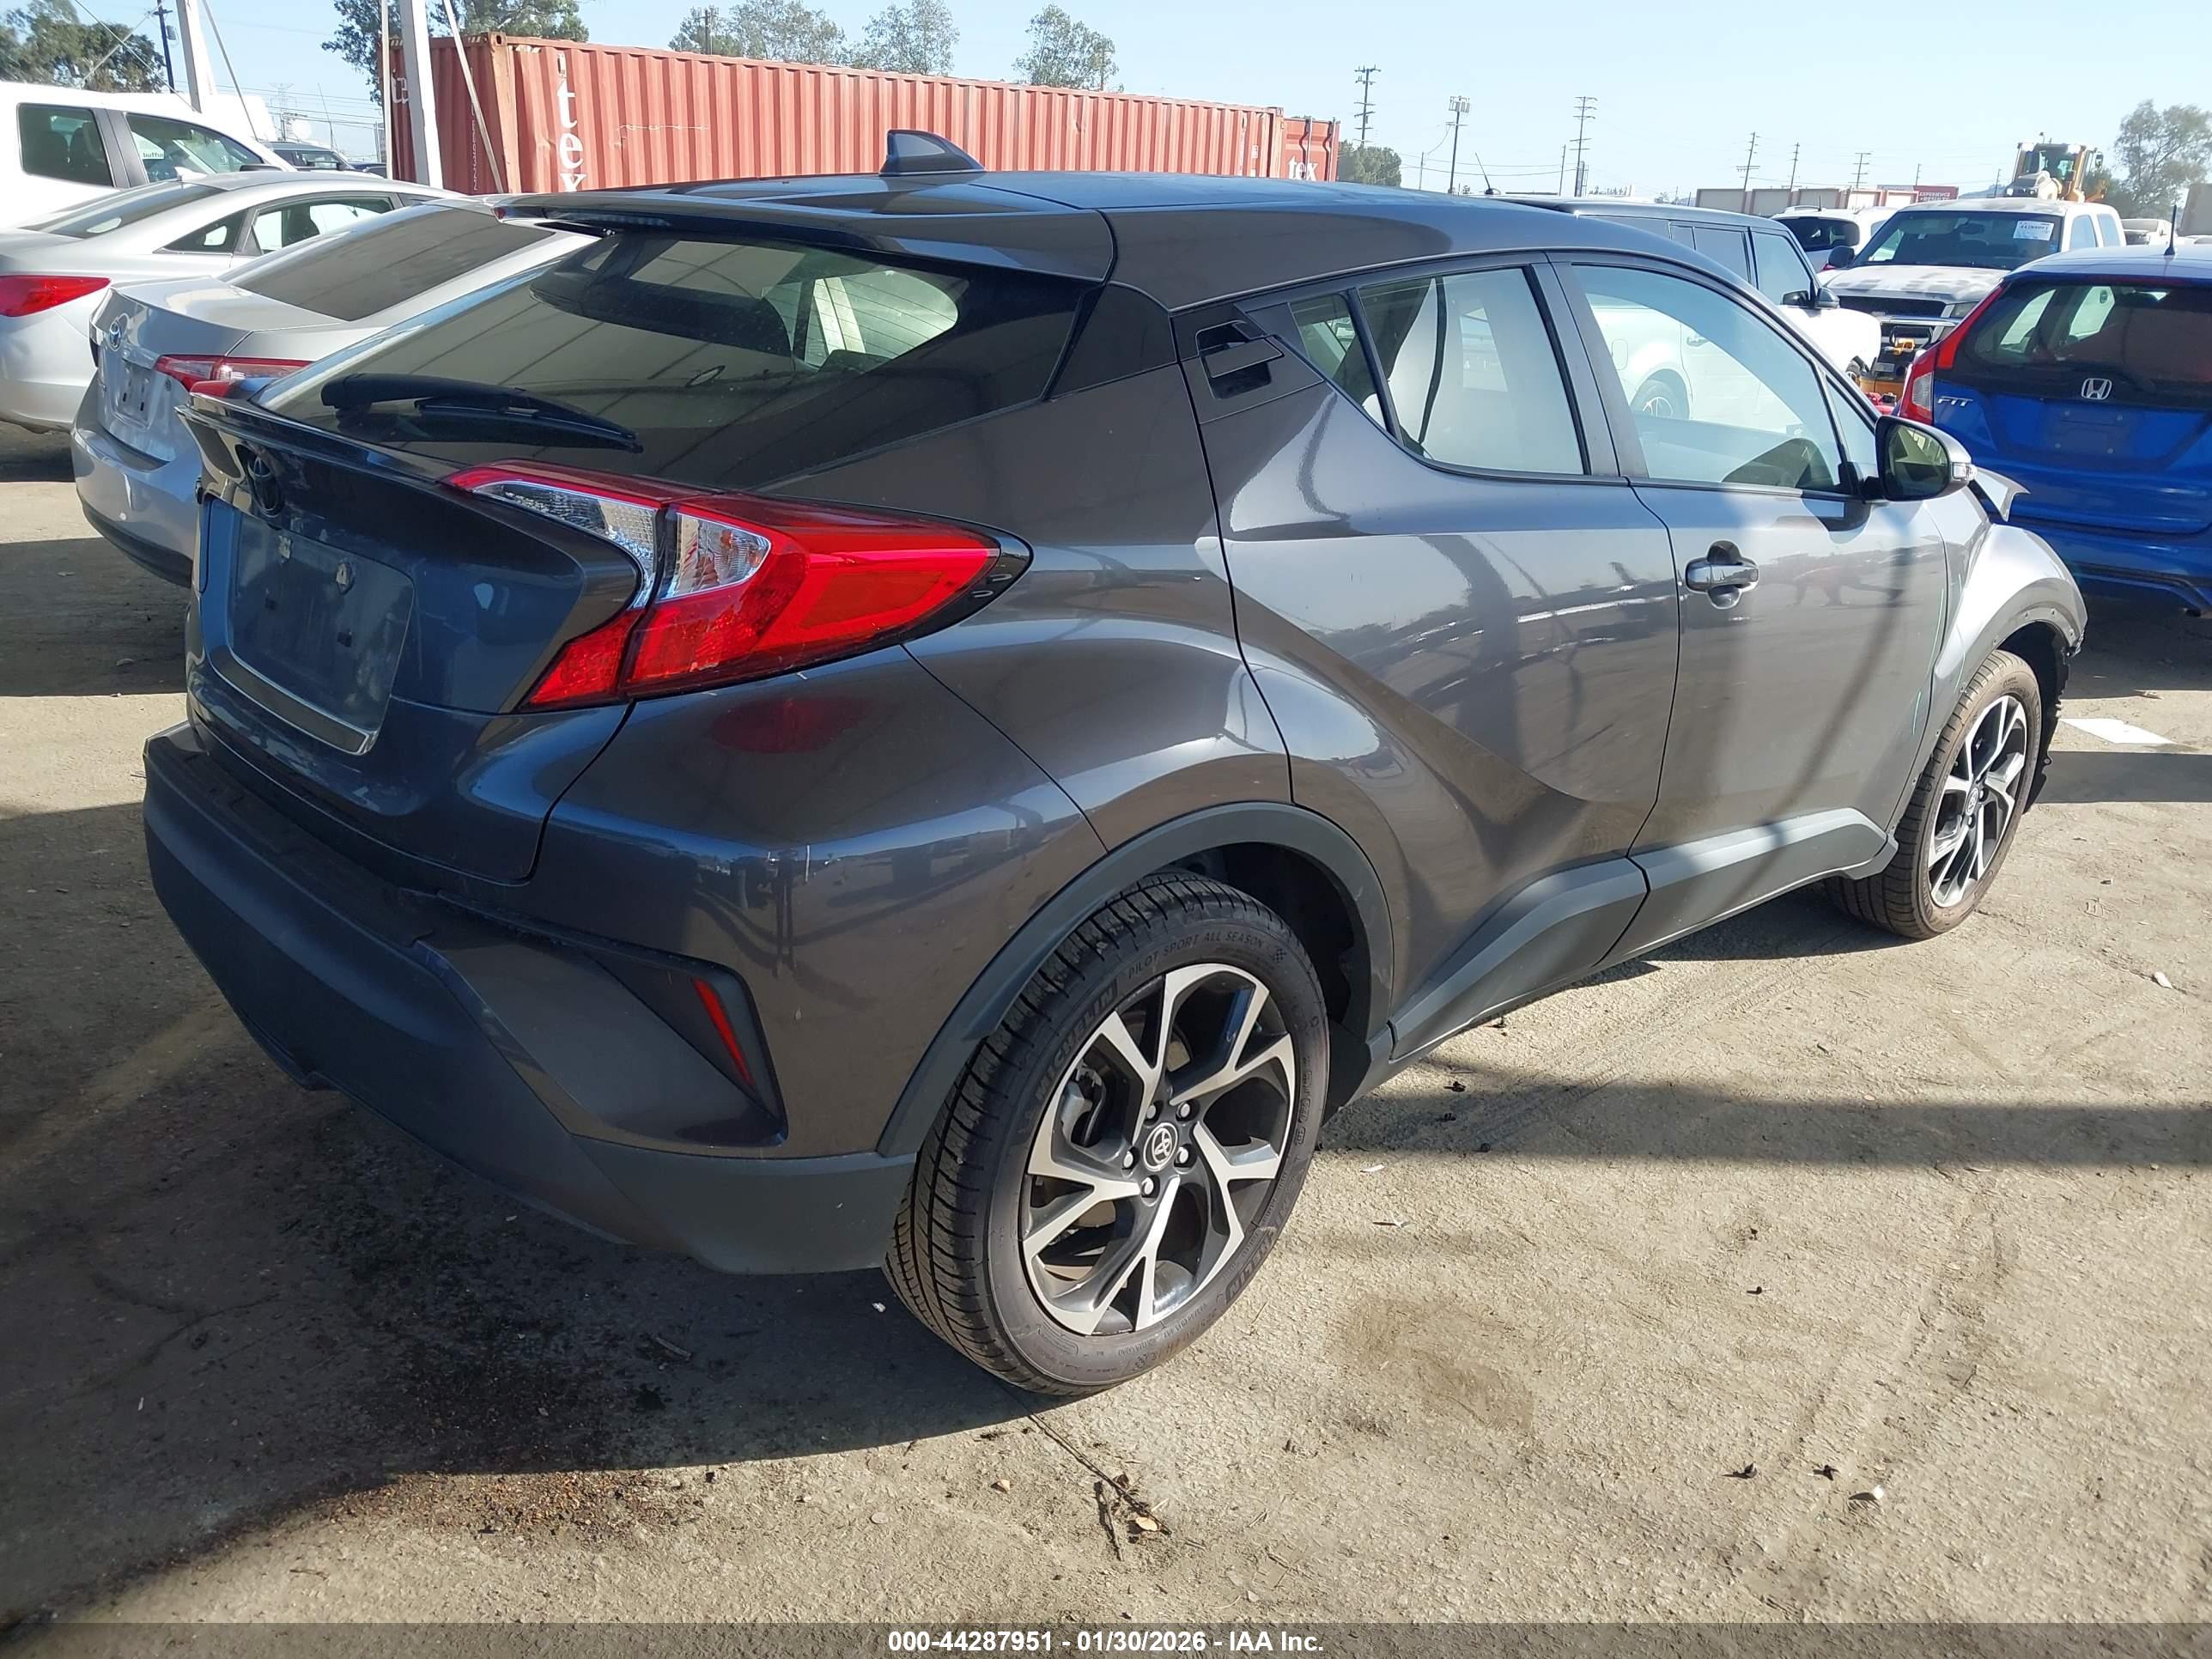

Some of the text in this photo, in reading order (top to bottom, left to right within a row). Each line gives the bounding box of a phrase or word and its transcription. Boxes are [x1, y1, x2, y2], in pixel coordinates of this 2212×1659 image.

[1288, 155, 1319, 182] tex
[1937, 395, 1974, 407] FIT
[1127, 931, 1266, 980] PILOT SPORT ALL SEASON
[1036, 986, 1115, 1099] MICHELIN
